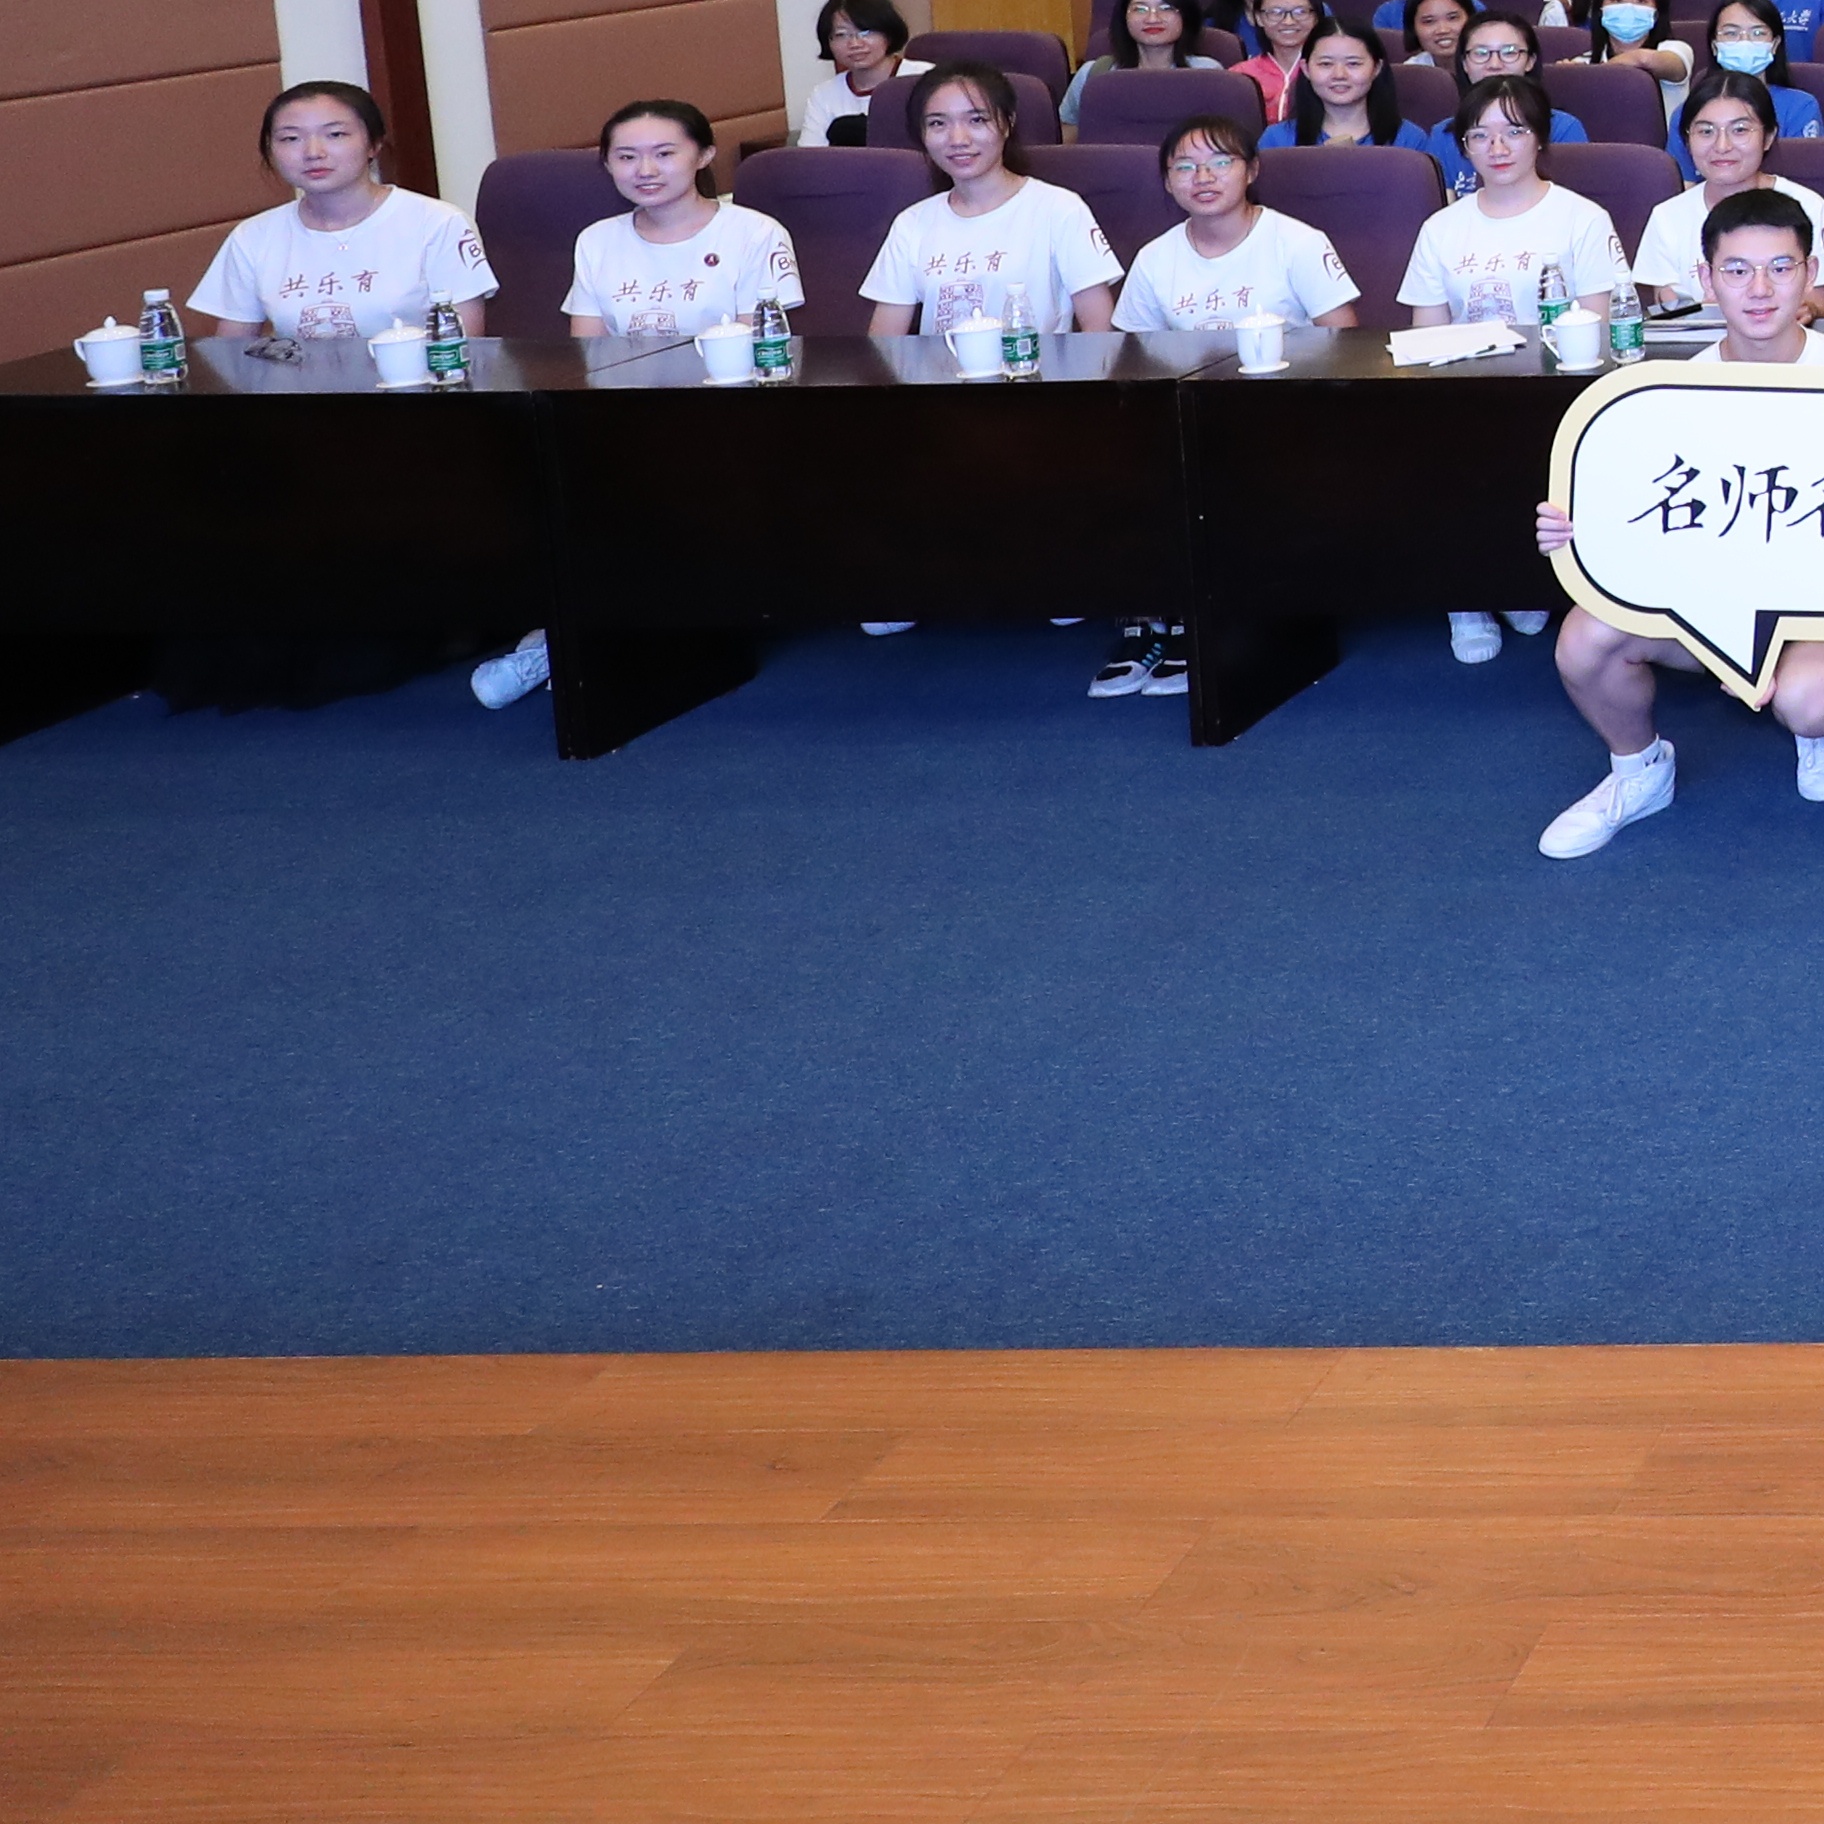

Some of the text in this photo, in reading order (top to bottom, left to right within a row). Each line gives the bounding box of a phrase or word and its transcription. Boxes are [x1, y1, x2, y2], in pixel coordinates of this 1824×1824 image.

[924, 250, 1007, 278] 共乐育
[1453, 250, 1536, 276] 共乐育
[279, 269, 379, 299] 共乐育
[612, 278, 706, 304] 共乐育
[1172, 286, 1255, 316] 共乐育
